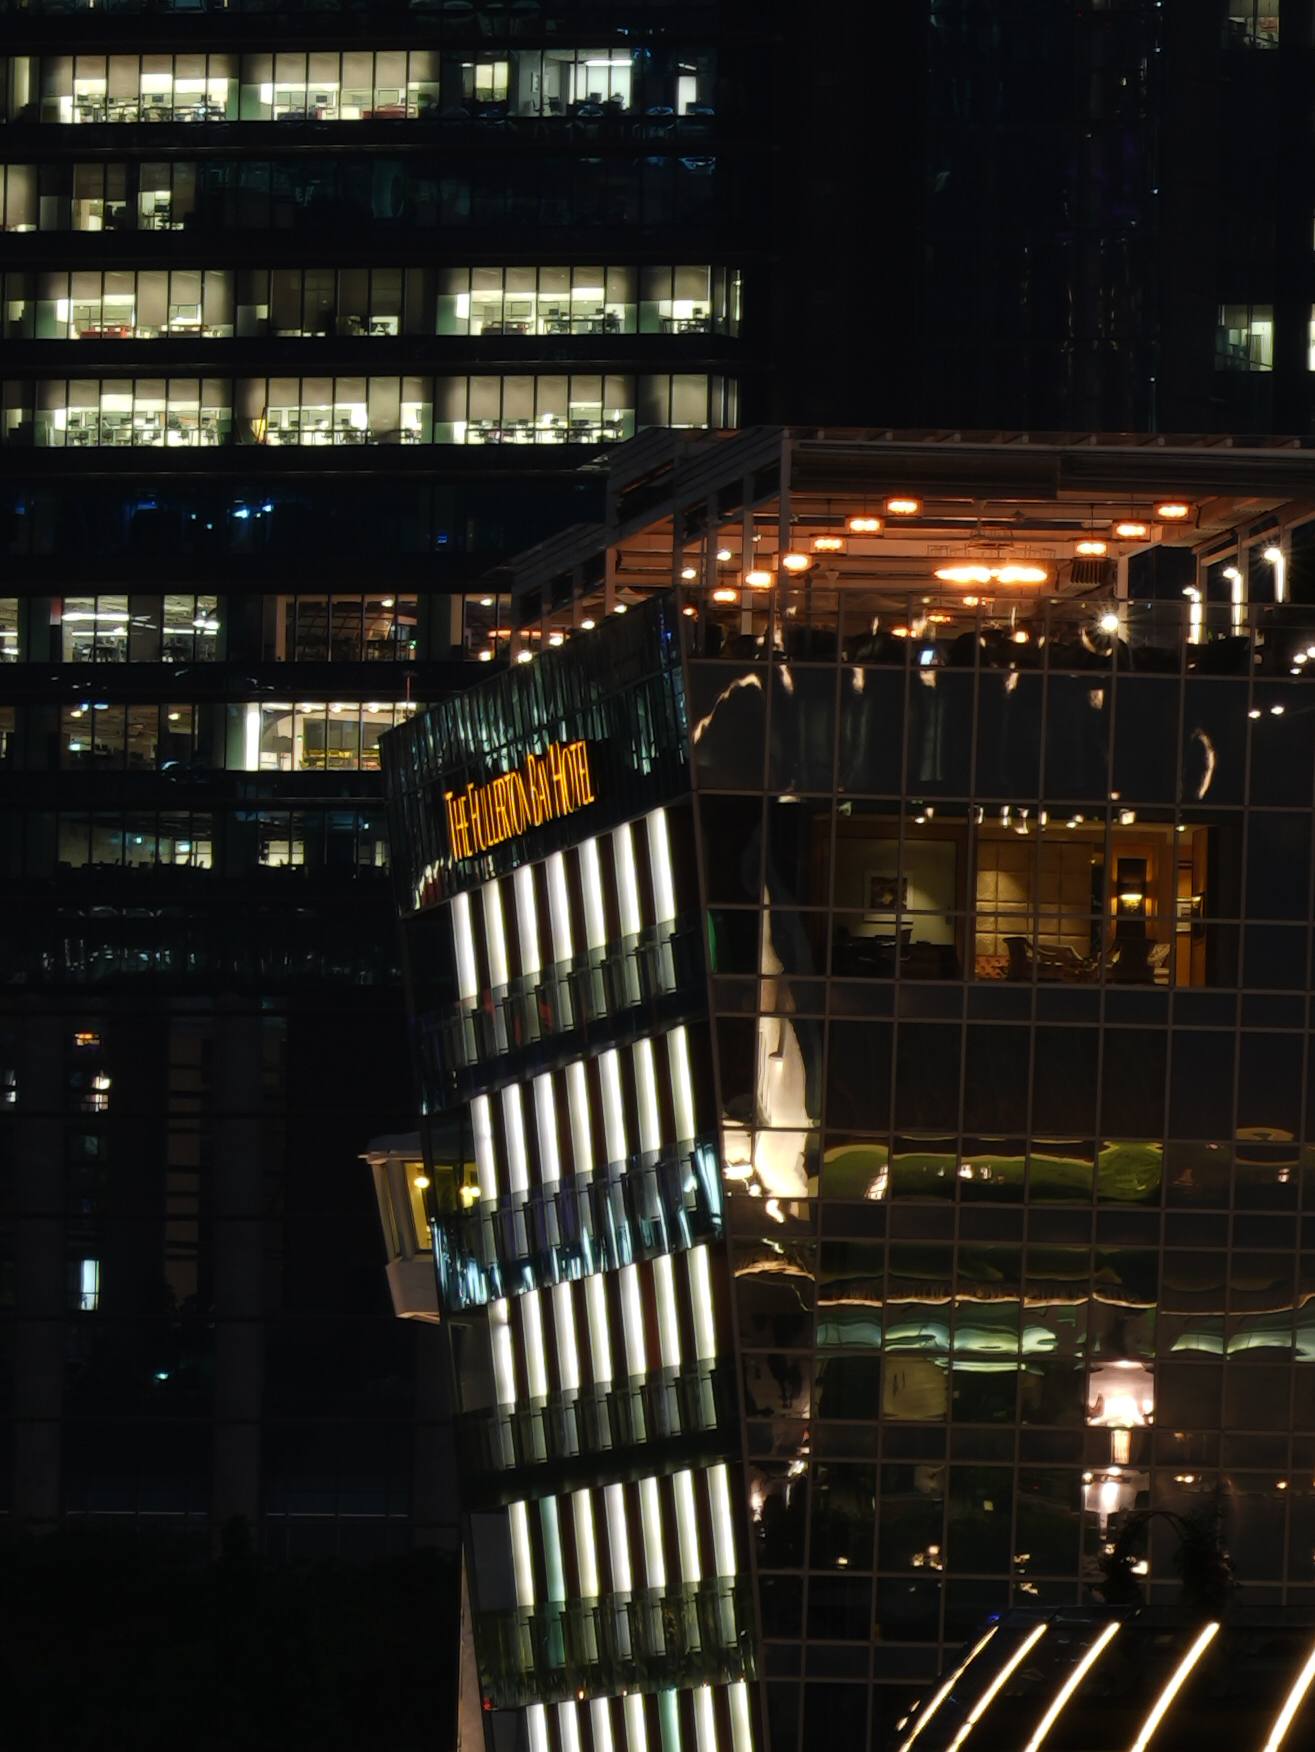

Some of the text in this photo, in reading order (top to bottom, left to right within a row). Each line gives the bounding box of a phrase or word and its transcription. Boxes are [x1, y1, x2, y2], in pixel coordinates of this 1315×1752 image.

[444, 740, 595, 862] THE FULLERTON BAY HOTEL
